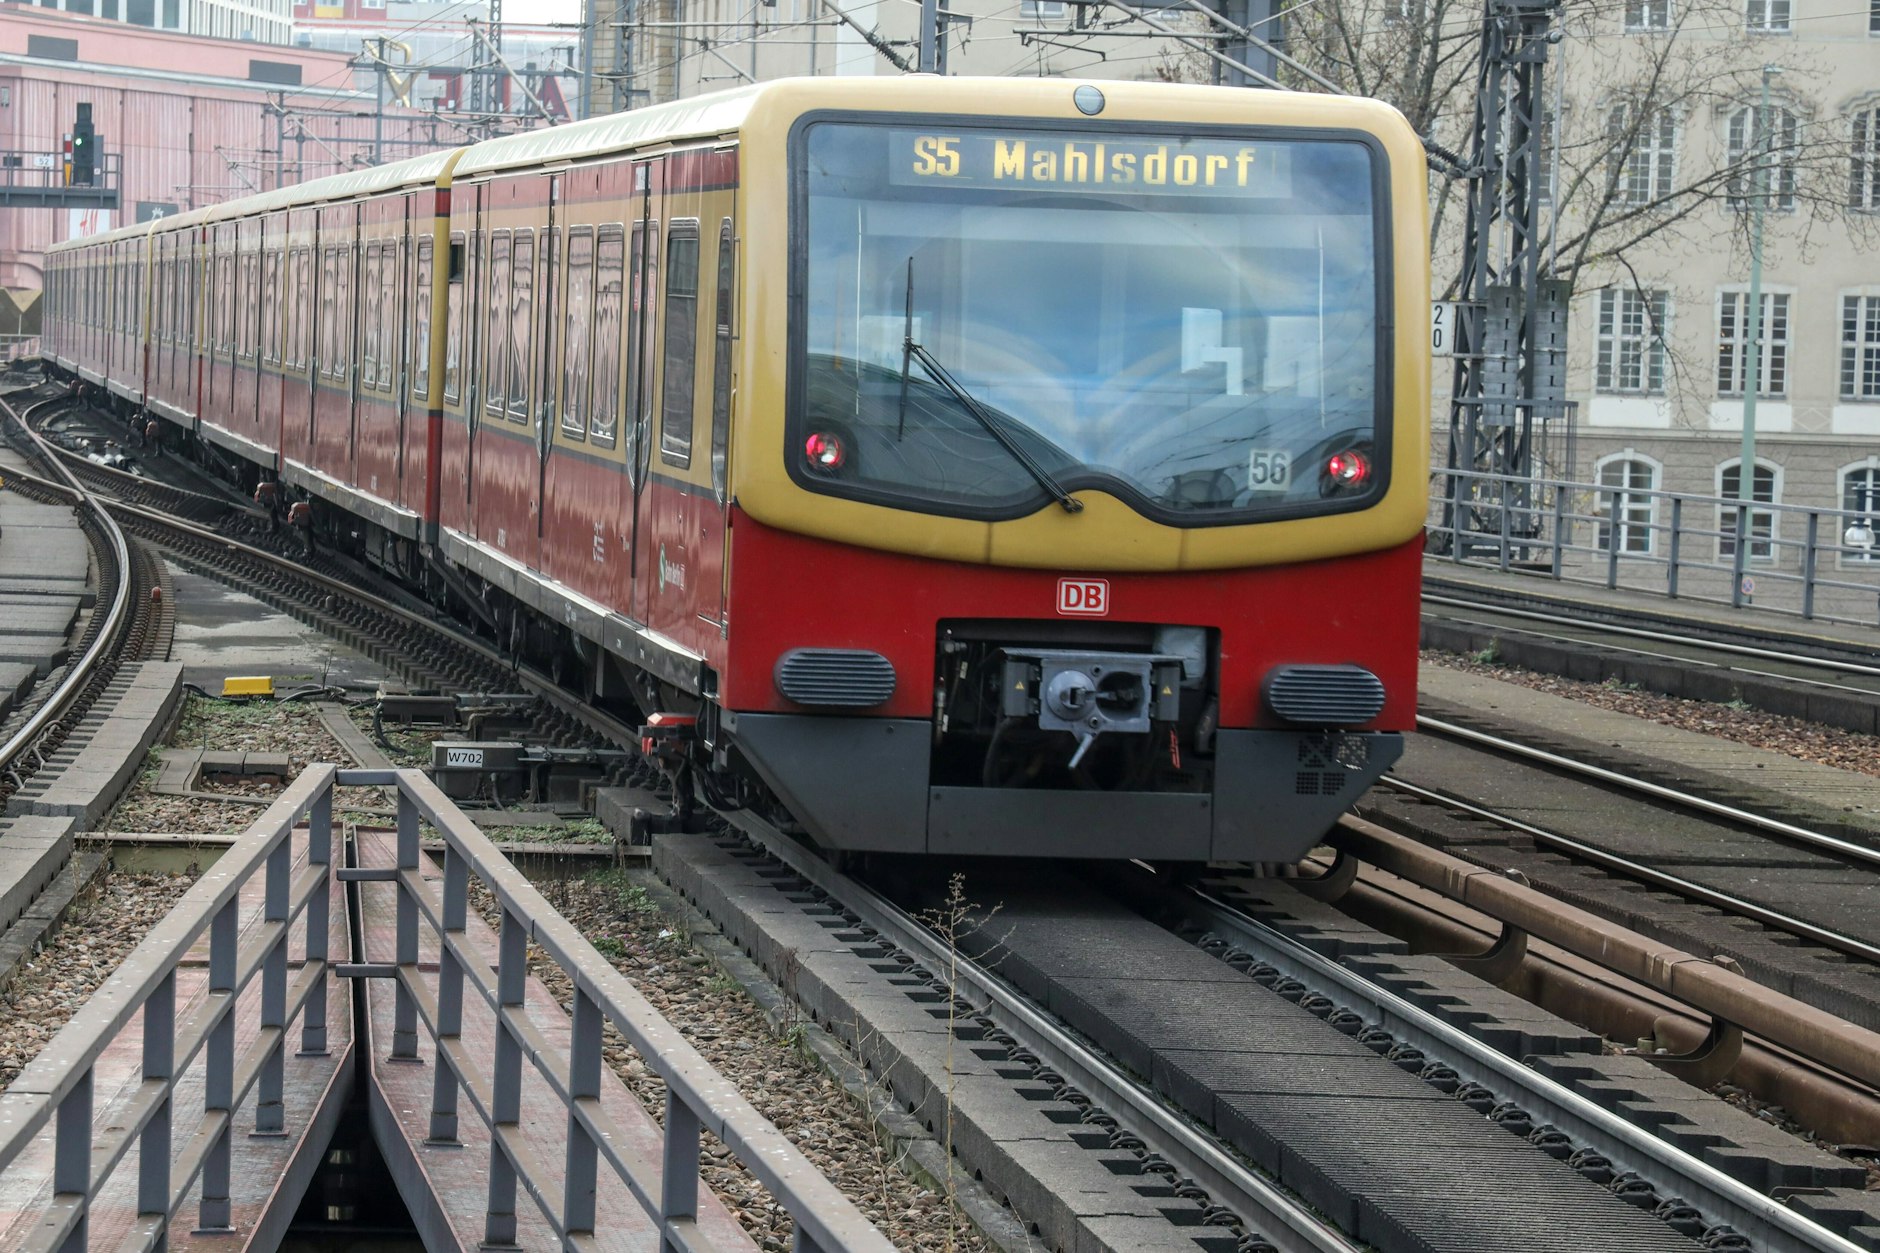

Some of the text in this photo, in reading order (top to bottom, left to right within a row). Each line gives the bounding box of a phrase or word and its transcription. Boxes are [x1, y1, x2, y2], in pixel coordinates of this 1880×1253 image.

[39, 157, 50, 166] 52
[913, 136, 1257, 187] S5 Mahlsdorf
[1434, 305, 1443, 324] 2
[1433, 328, 1442, 348] 0
[1252, 452, 1287, 485] 56
[1065, 584, 1102, 608] DB
[448, 752, 482, 764] W702
